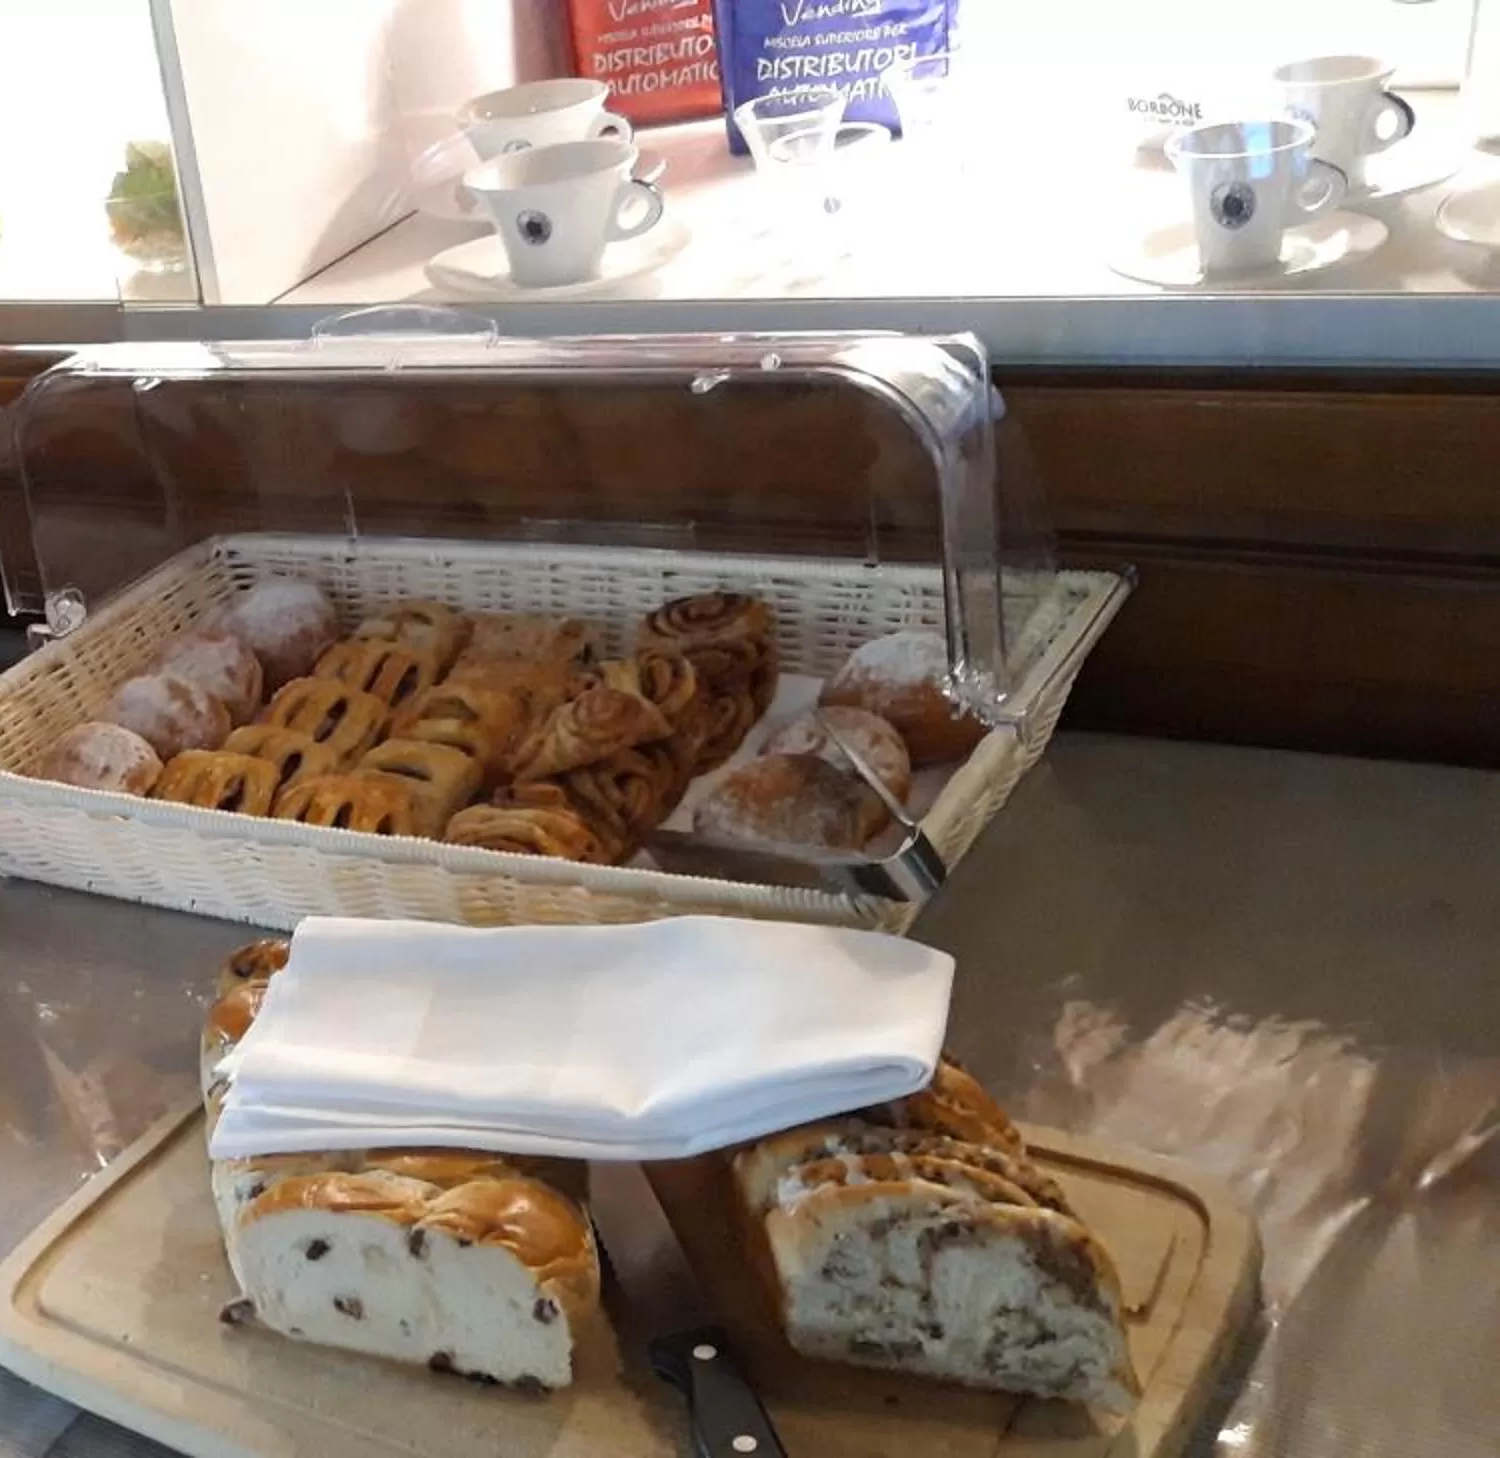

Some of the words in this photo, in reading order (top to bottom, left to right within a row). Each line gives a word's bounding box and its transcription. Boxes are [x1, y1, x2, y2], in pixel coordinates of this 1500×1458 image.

[593, 34, 714, 74] DISTRIBUTO
[757, 42, 917, 81] DISTRIBUTORI
[607, 61, 719, 96] AUTOMATIC
[1127, 97, 1204, 120] BORBONE
